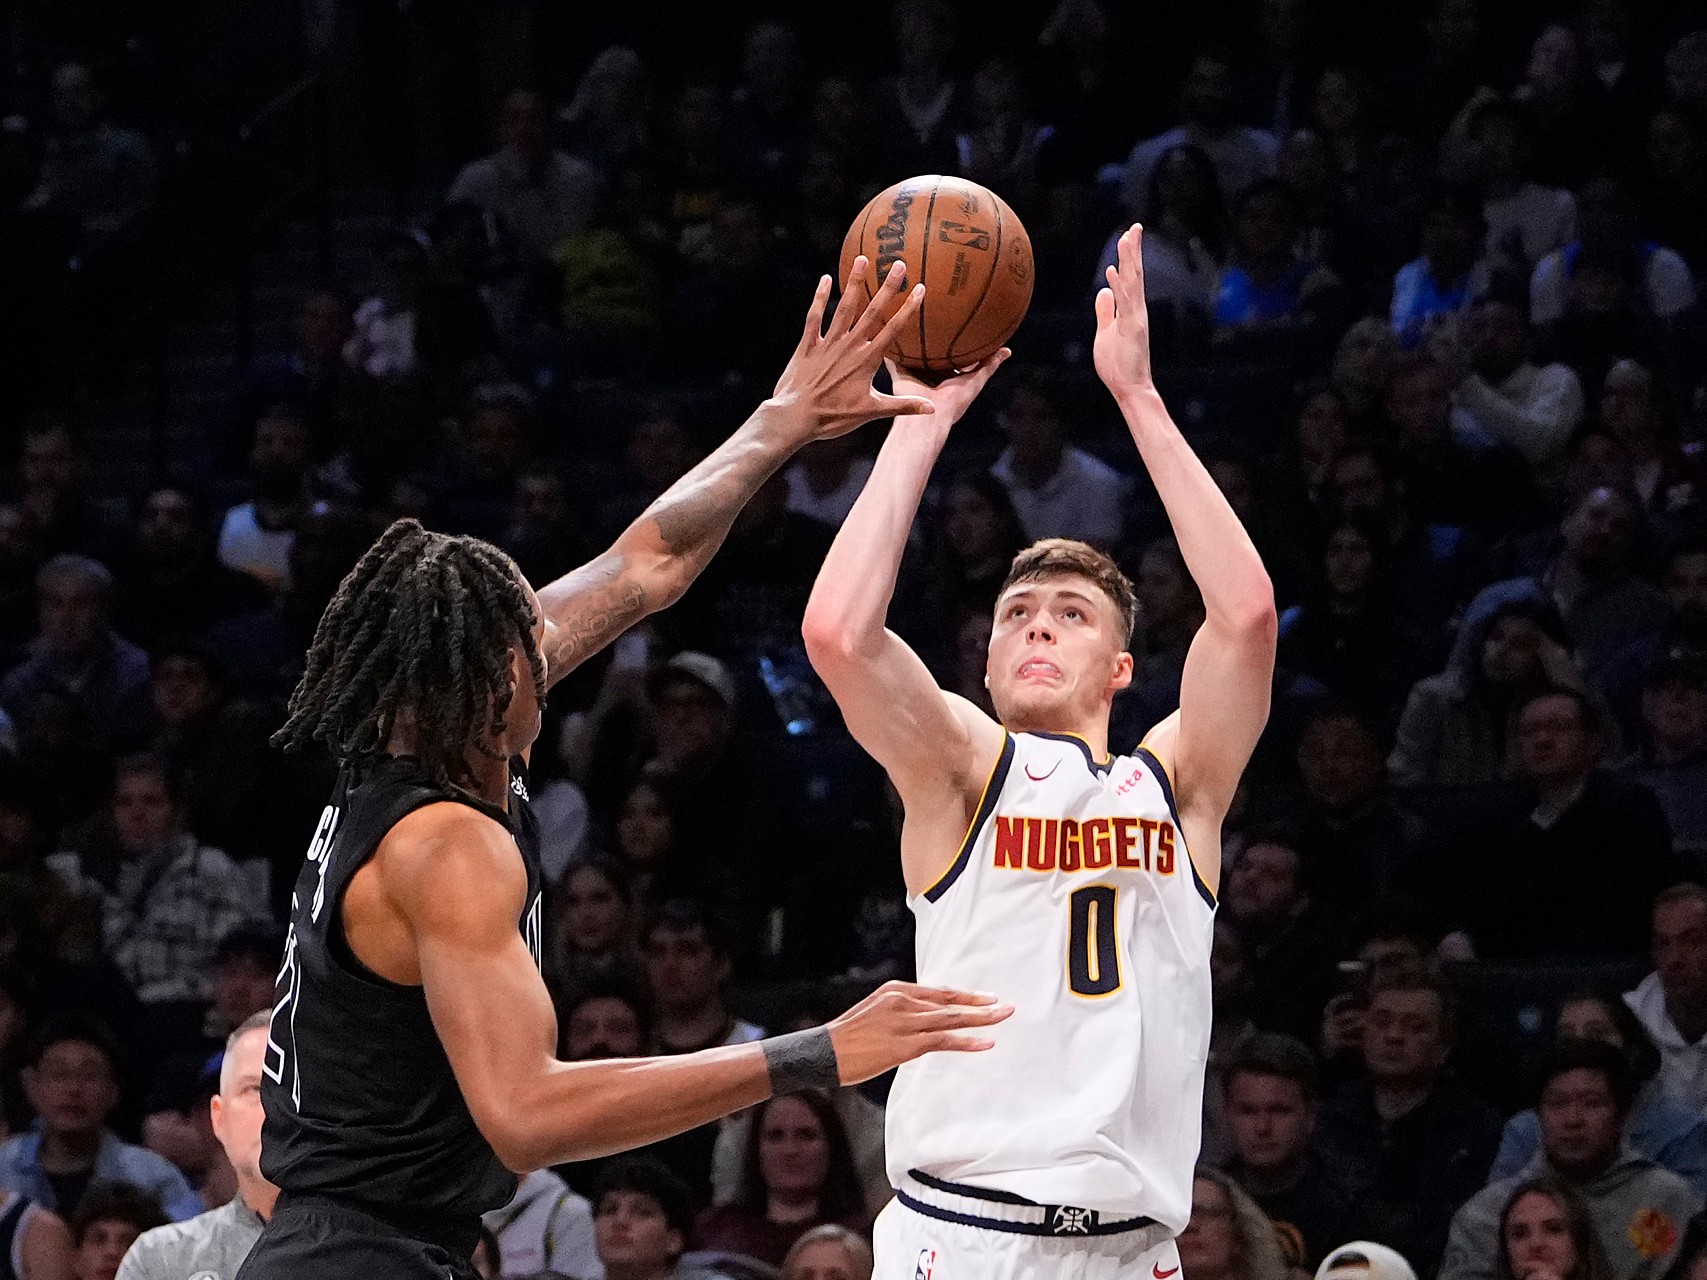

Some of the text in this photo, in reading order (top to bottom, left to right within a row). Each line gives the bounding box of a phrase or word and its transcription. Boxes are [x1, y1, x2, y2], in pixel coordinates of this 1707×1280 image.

[1115, 768, 1143, 797] tta
[993, 816, 1175, 876] NUGGETS
[1066, 881, 1123, 998] 0
